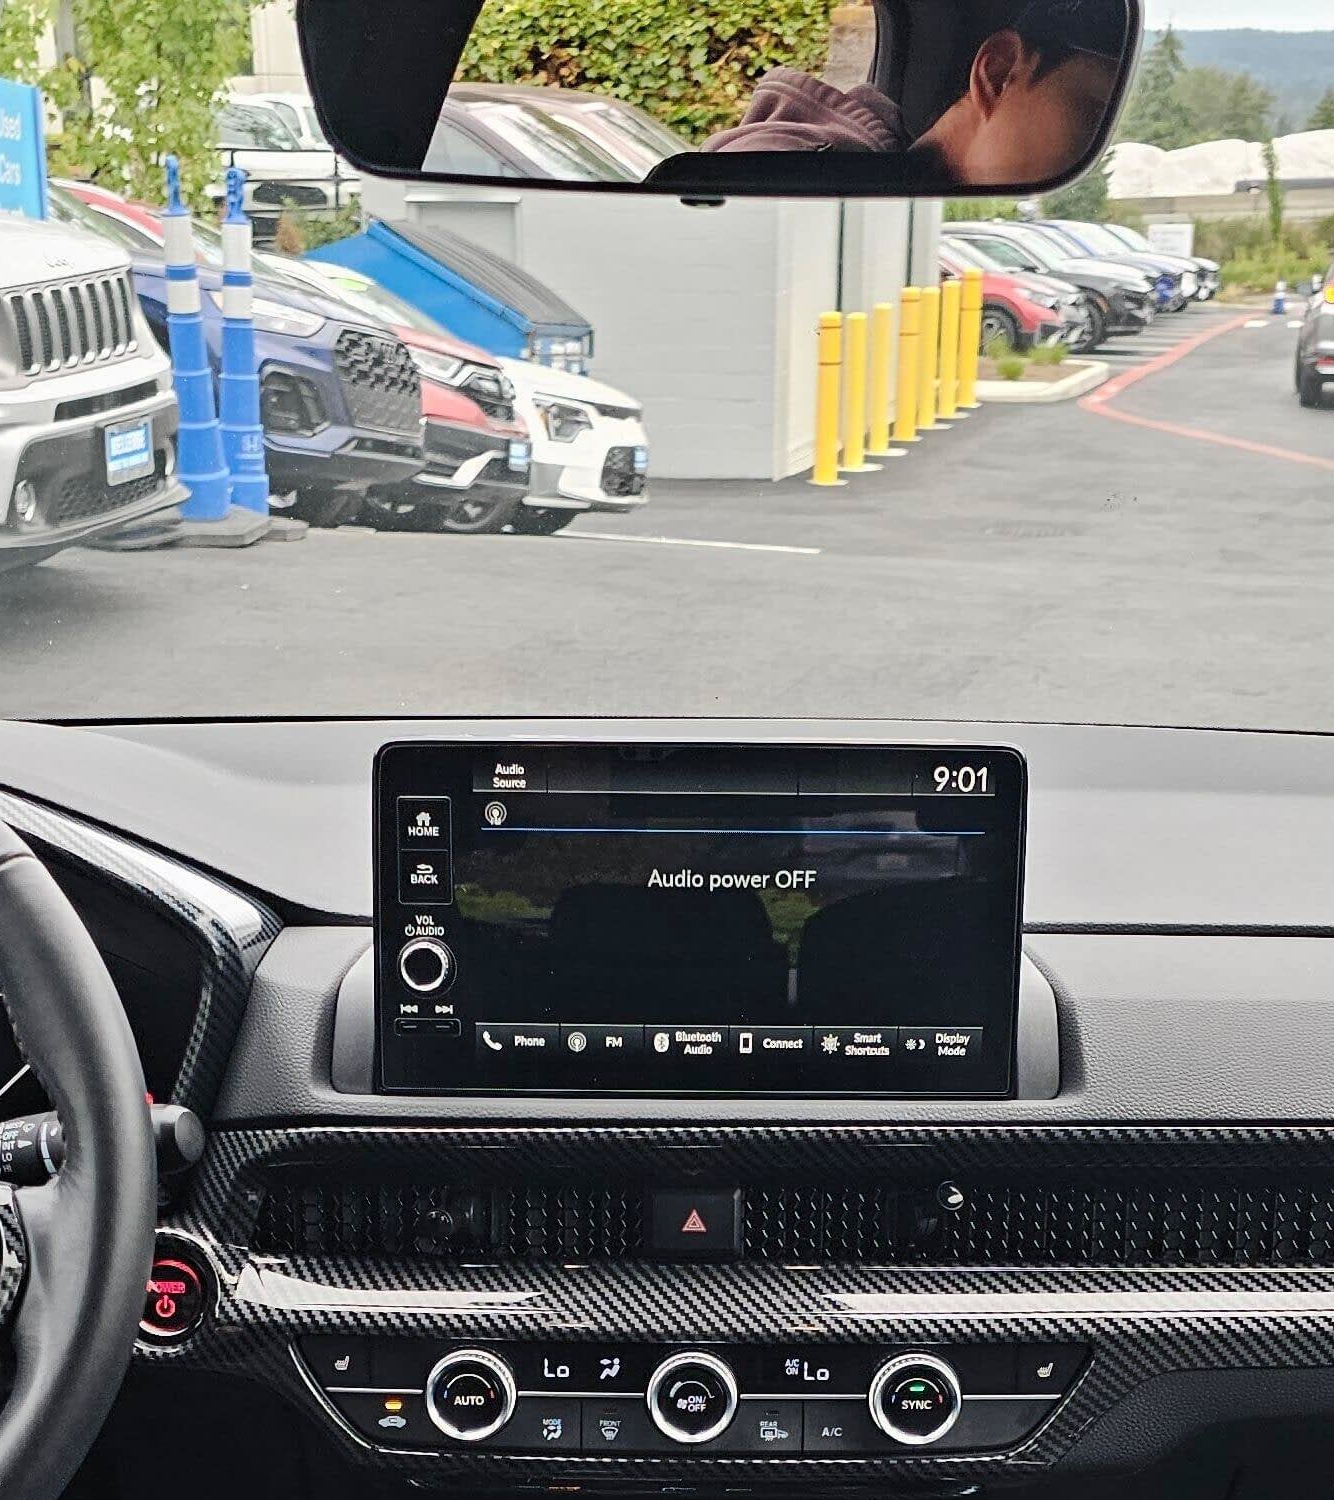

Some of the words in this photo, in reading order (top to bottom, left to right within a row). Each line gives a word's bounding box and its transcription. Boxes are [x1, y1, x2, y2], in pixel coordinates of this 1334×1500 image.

[495, 763, 525, 775] Audio
[493, 777, 527, 789] Source
[933, 766, 989, 793] 9:01
[408, 826, 440, 837] HOME
[410, 874, 439, 885] BACK
[647, 868, 704, 889] Audio
[709, 871, 770, 892] power
[775, 869, 817, 889] OFF
[415, 914, 435, 926] VOL
[415, 926, 445, 937] AUDIO
[514, 1035, 546, 1047] Phone
[605, 1036, 623, 1047] FM
[675, 1031, 722, 1043] Bluetooth
[853, 1033, 882, 1044] Smart
[935, 1033, 971, 1045] Display
[762, 1038, 804, 1049] Connect
[683, 1044, 713, 1055] Audio
[844, 1045, 890, 1056] Shortcuts
[937, 1045, 966, 1056] Mode
[2, 1130, 19, 1140] OFF
[2, 1152, 13, 1162] LO
[543, 1358, 570, 1378] Lo
[785, 1358, 800, 1368] A/C
[785, 1367, 799, 1376] ON
[803, 1361, 830, 1381] Lo
[453, 1396, 485, 1406] AUTO
[687, 1395, 707, 1404] ON/
[901, 1400, 933, 1410] SYNC
[687, 1403, 706, 1413] OFF
[542, 1418, 562, 1426] MODE
[599, 1419, 622, 1427] FRONT
[821, 1427, 843, 1437] A/C
